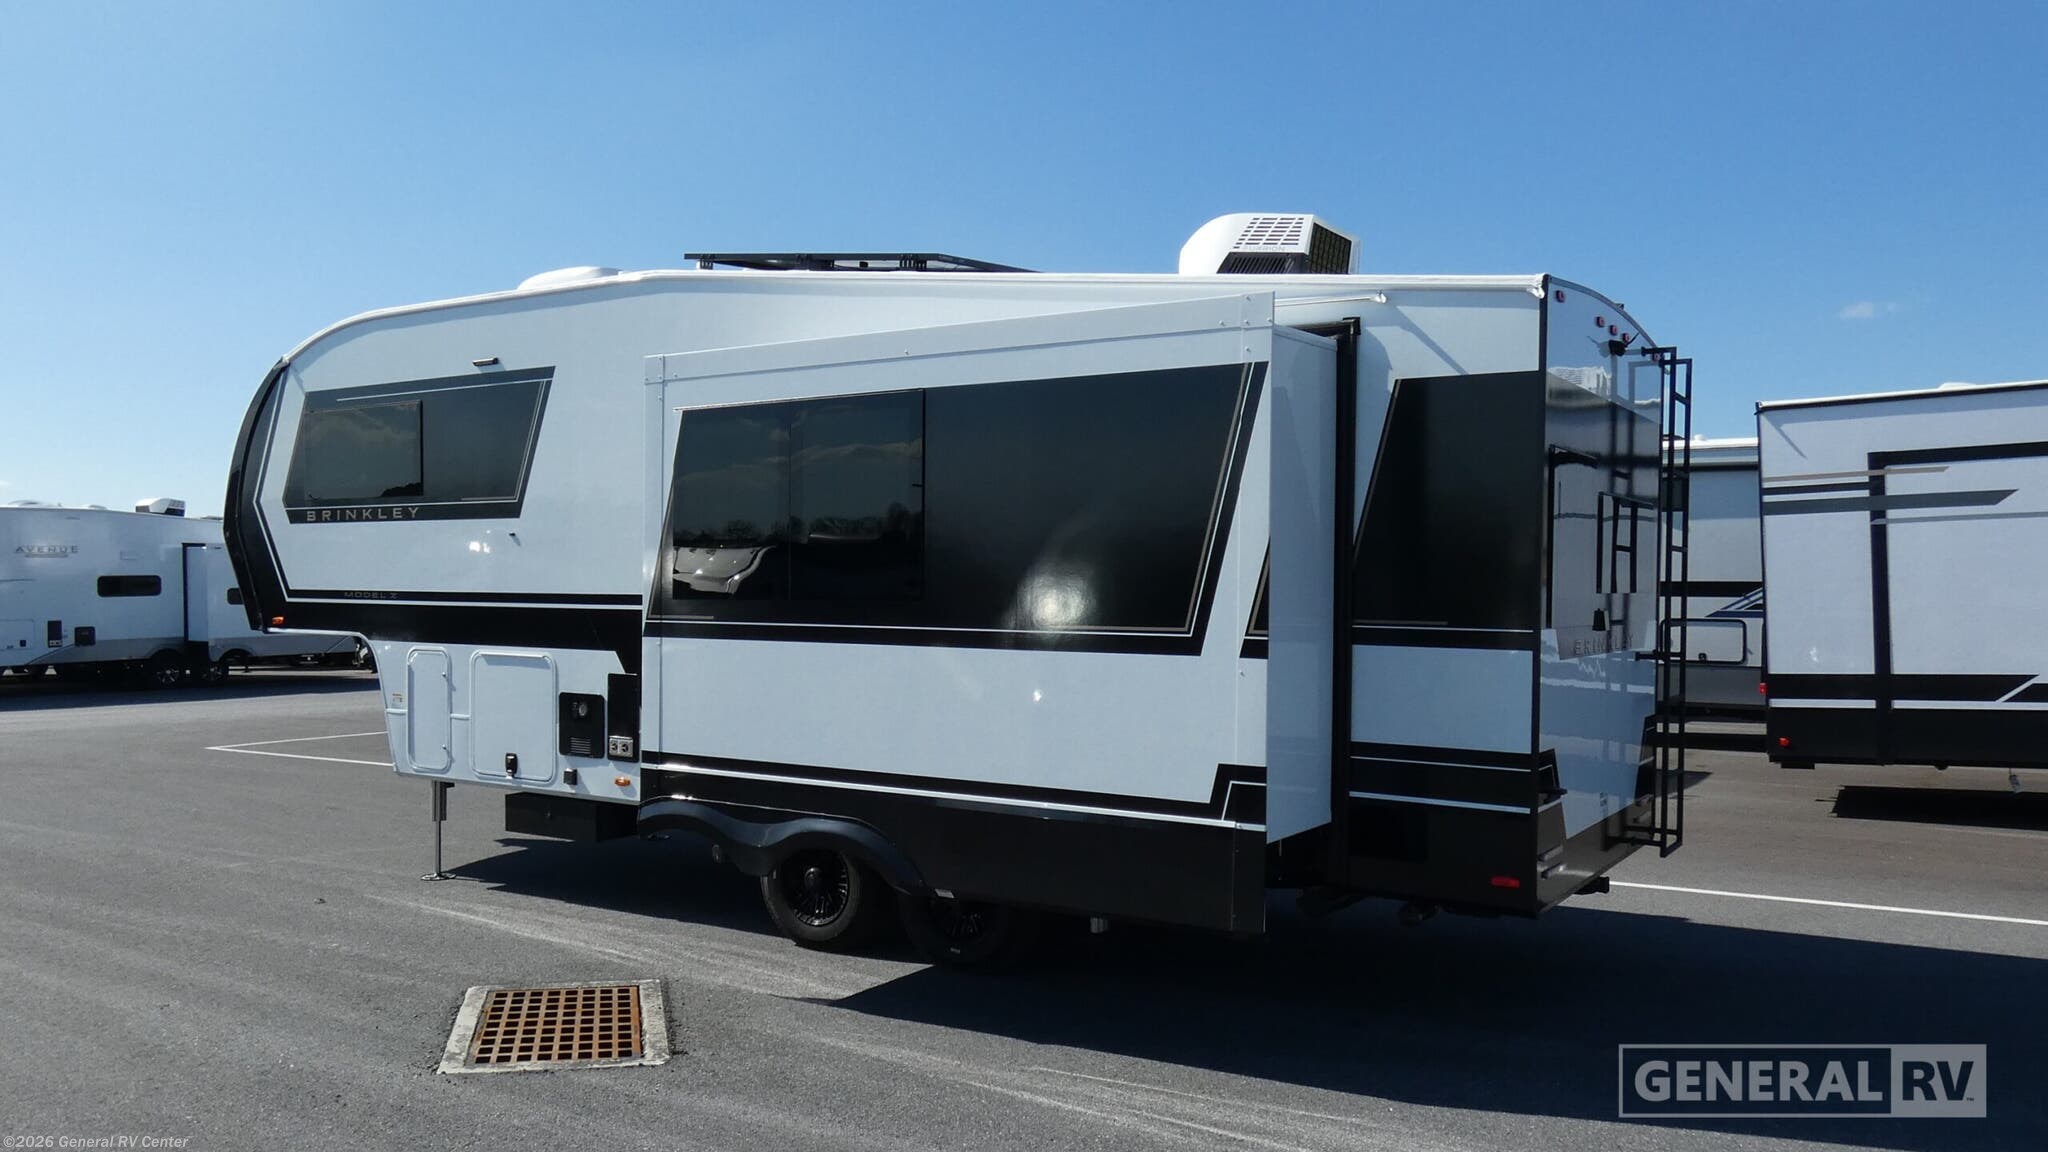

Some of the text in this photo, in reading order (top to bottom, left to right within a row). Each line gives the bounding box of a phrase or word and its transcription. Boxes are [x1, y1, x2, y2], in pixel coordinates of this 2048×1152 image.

[306, 507, 420, 521] BRINKLEY
[14, 545, 80, 554] AVENUE
[344, 591, 386, 600] MODEL
